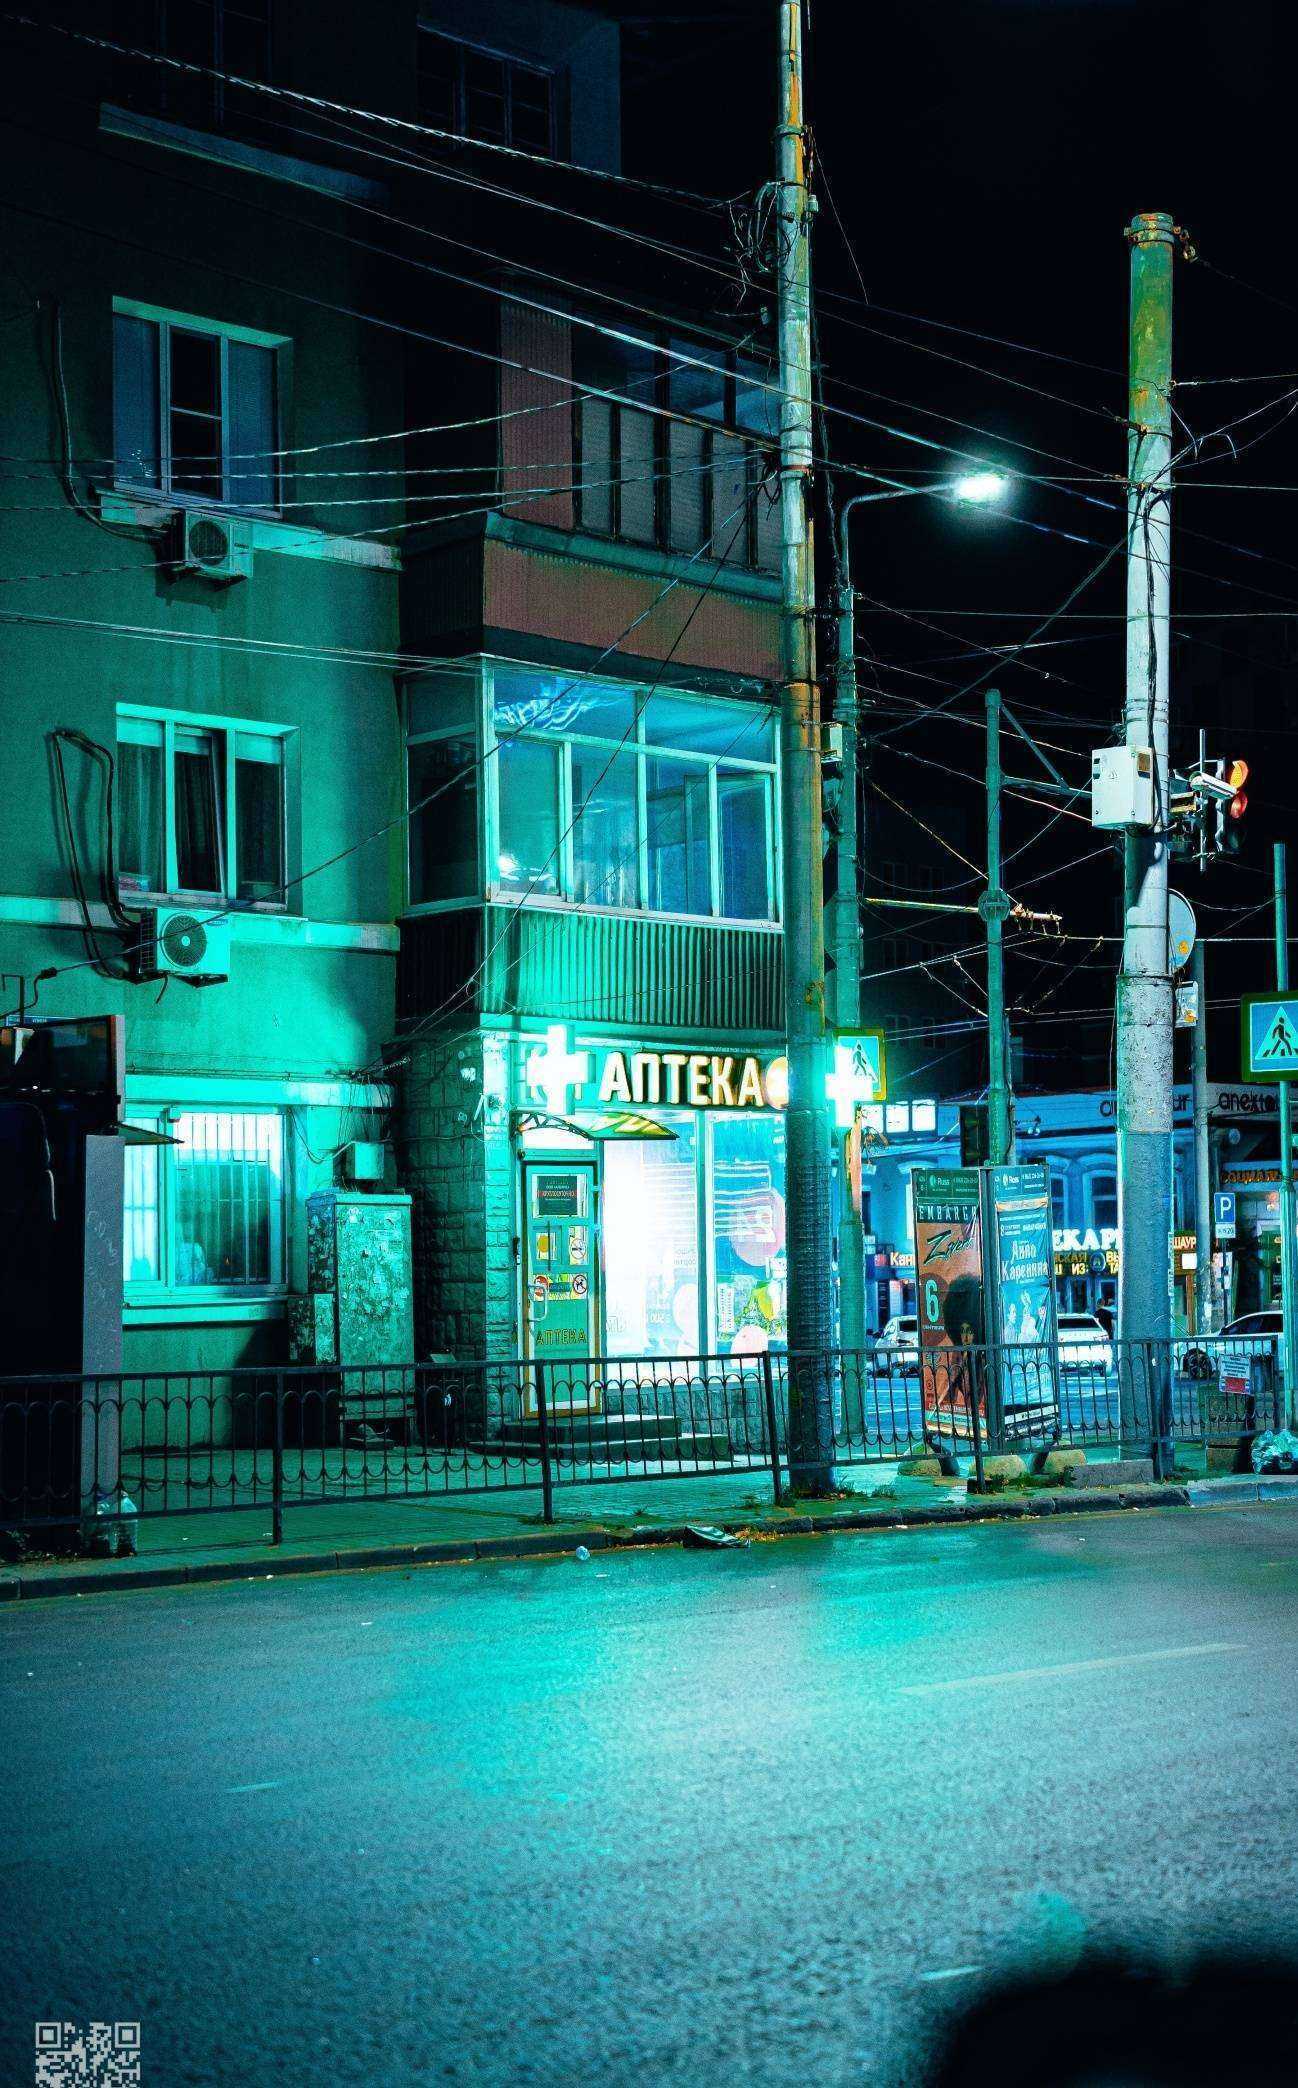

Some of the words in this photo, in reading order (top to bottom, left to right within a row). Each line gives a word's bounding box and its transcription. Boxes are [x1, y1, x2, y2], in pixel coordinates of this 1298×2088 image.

[600, 1051, 765, 1107] АПТЕКА
[1220, 1196, 1232, 1219] P
[890, 1251, 915, 1266] Кан
[924, 1279, 940, 1324] 6
[535, 1328, 588, 1346] АПТЕКА
